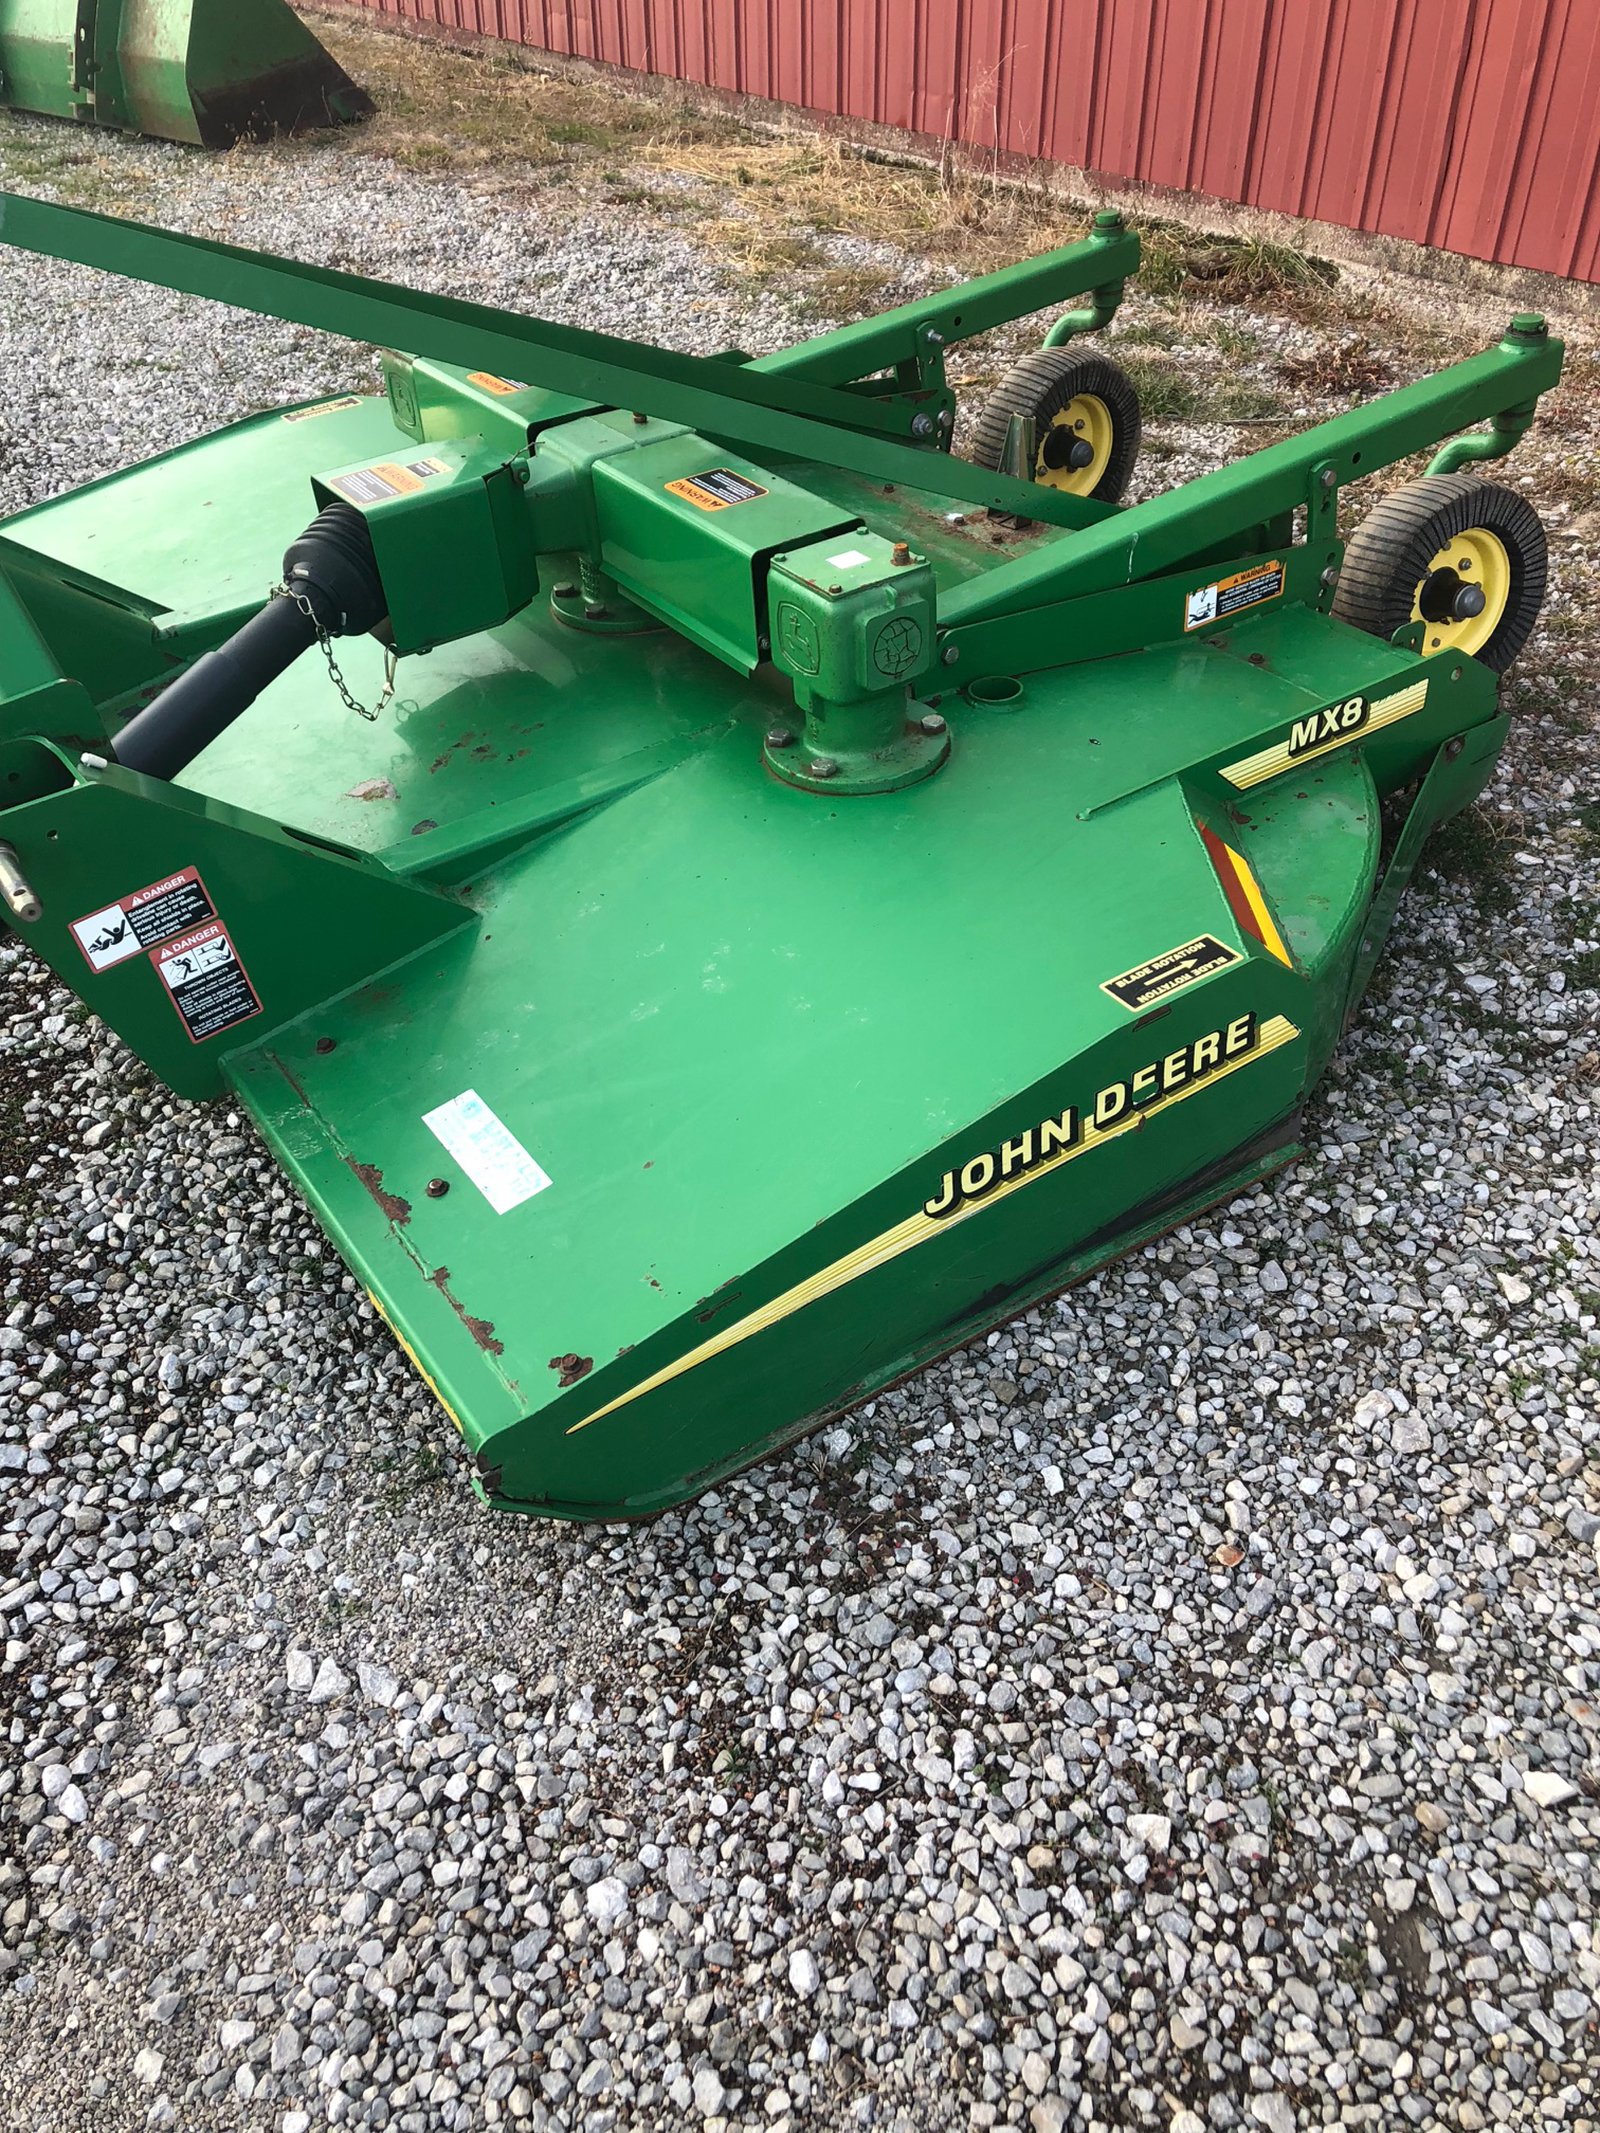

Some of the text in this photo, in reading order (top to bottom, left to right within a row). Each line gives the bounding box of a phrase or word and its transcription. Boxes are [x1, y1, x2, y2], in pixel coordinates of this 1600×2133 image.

[1240, 565, 1271, 580] WARNING
[1289, 696, 1366, 754] MX8
[128, 896, 168, 918] Entanglement
[174, 883, 198, 896] rotating
[142, 875, 185, 900] DANGER
[131, 895, 185, 923] driveline can cause
[134, 915, 155, 928] serious
[155, 907, 172, 918] injury
[136, 924, 152, 934] Keep
[161, 911, 181, 923] shields
[140, 929, 157, 940] Avoid
[157, 920, 180, 932] contact
[180, 913, 192, 922] with
[142, 932, 166, 945] rotating
[172, 926, 220, 952] DANGER
[1115, 942, 1206, 988] BLADE ROTATION
[1136, 956, 1228, 1004] BLADE ROTATION
[924, 1012, 1254, 1217] JOHN DEERE
